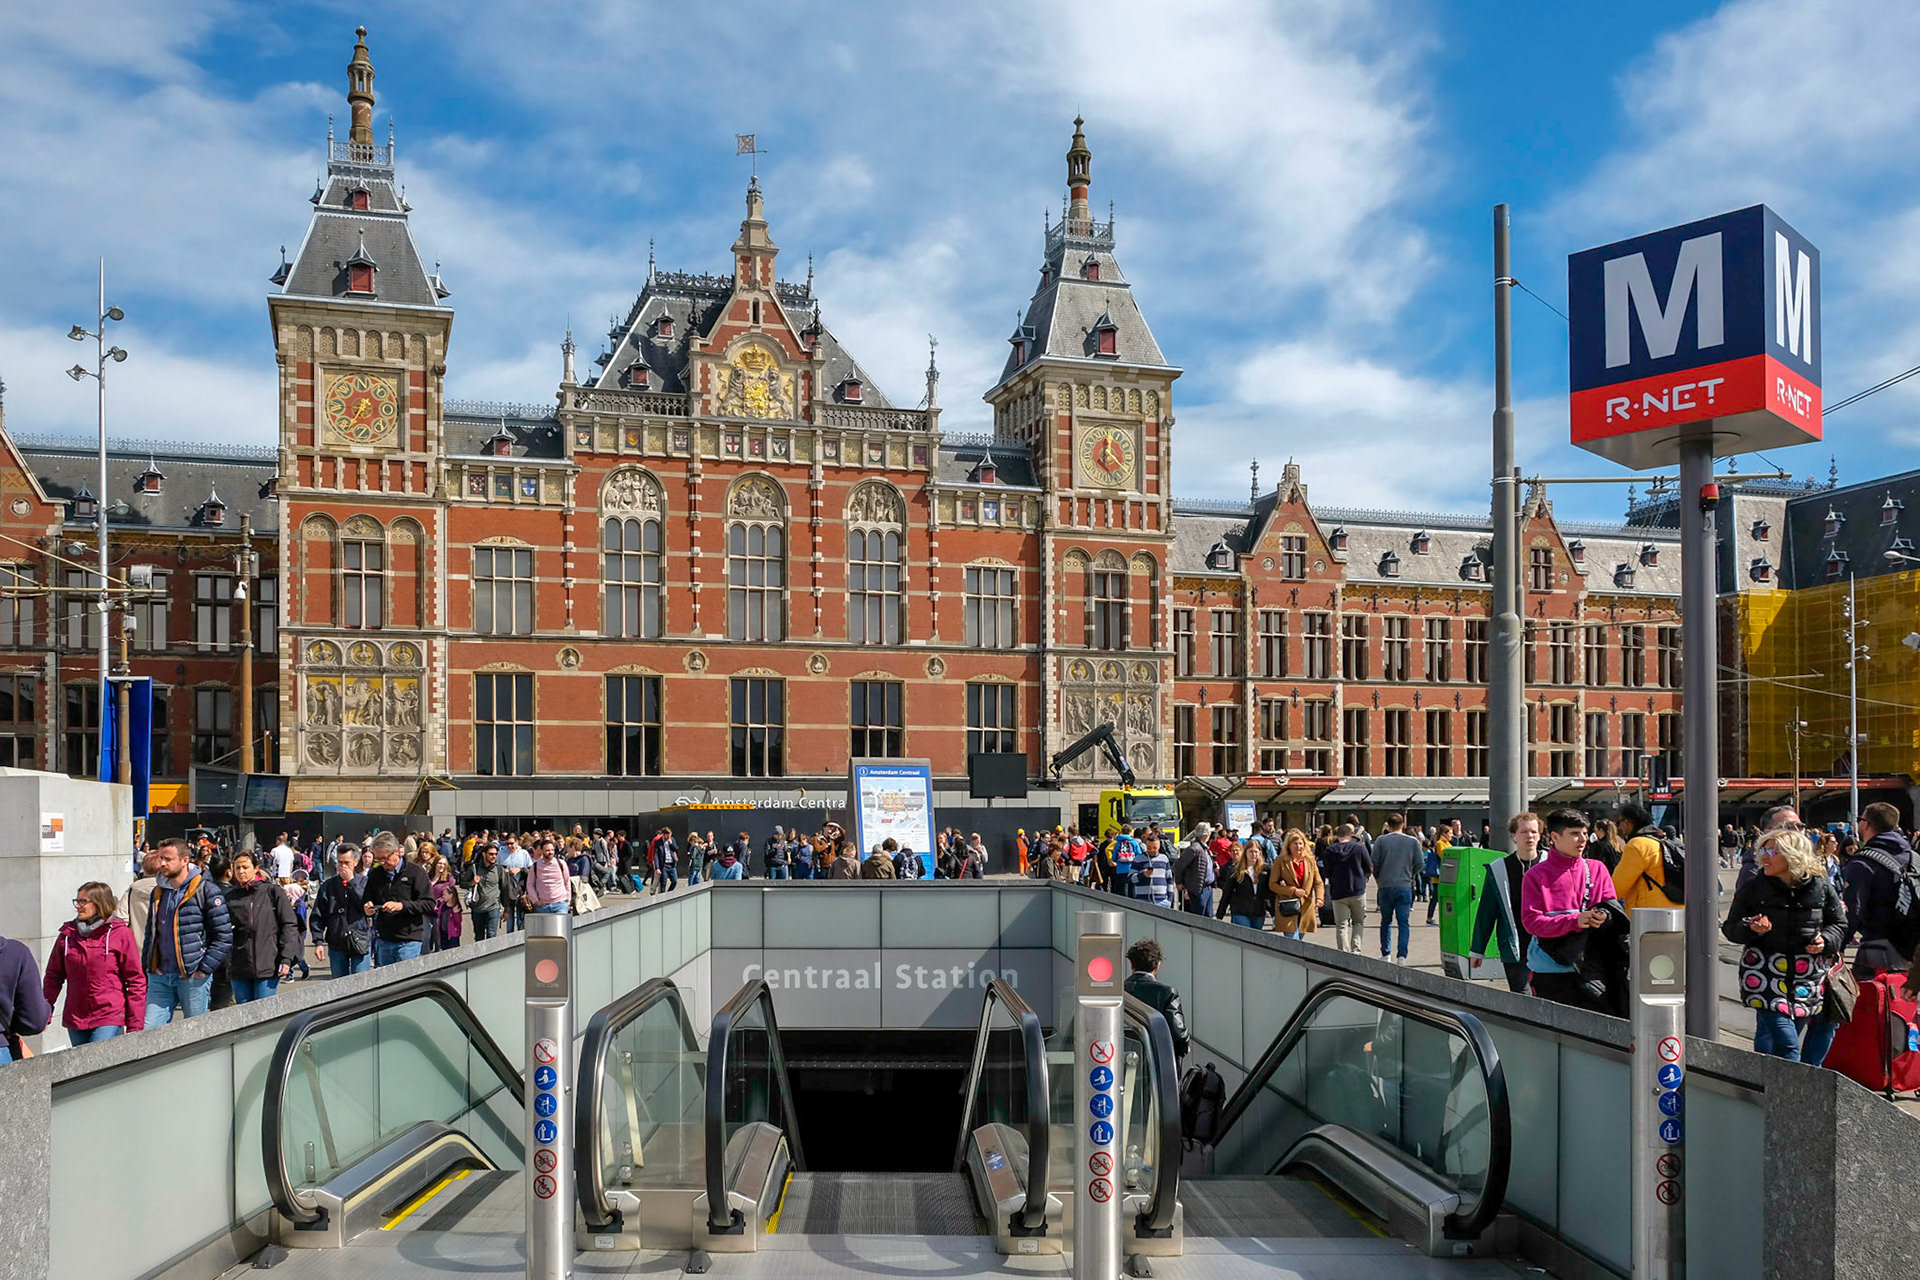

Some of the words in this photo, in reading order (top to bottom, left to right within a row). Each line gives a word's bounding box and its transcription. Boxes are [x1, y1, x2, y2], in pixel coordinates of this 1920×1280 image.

[1603, 231, 1725, 369] M
[1775, 230, 1812, 366] M
[356, 377, 368, 389] N
[382, 403, 394, 416] O
[741, 962, 881, 990] Centraal
[896, 962, 1019, 990] Station
